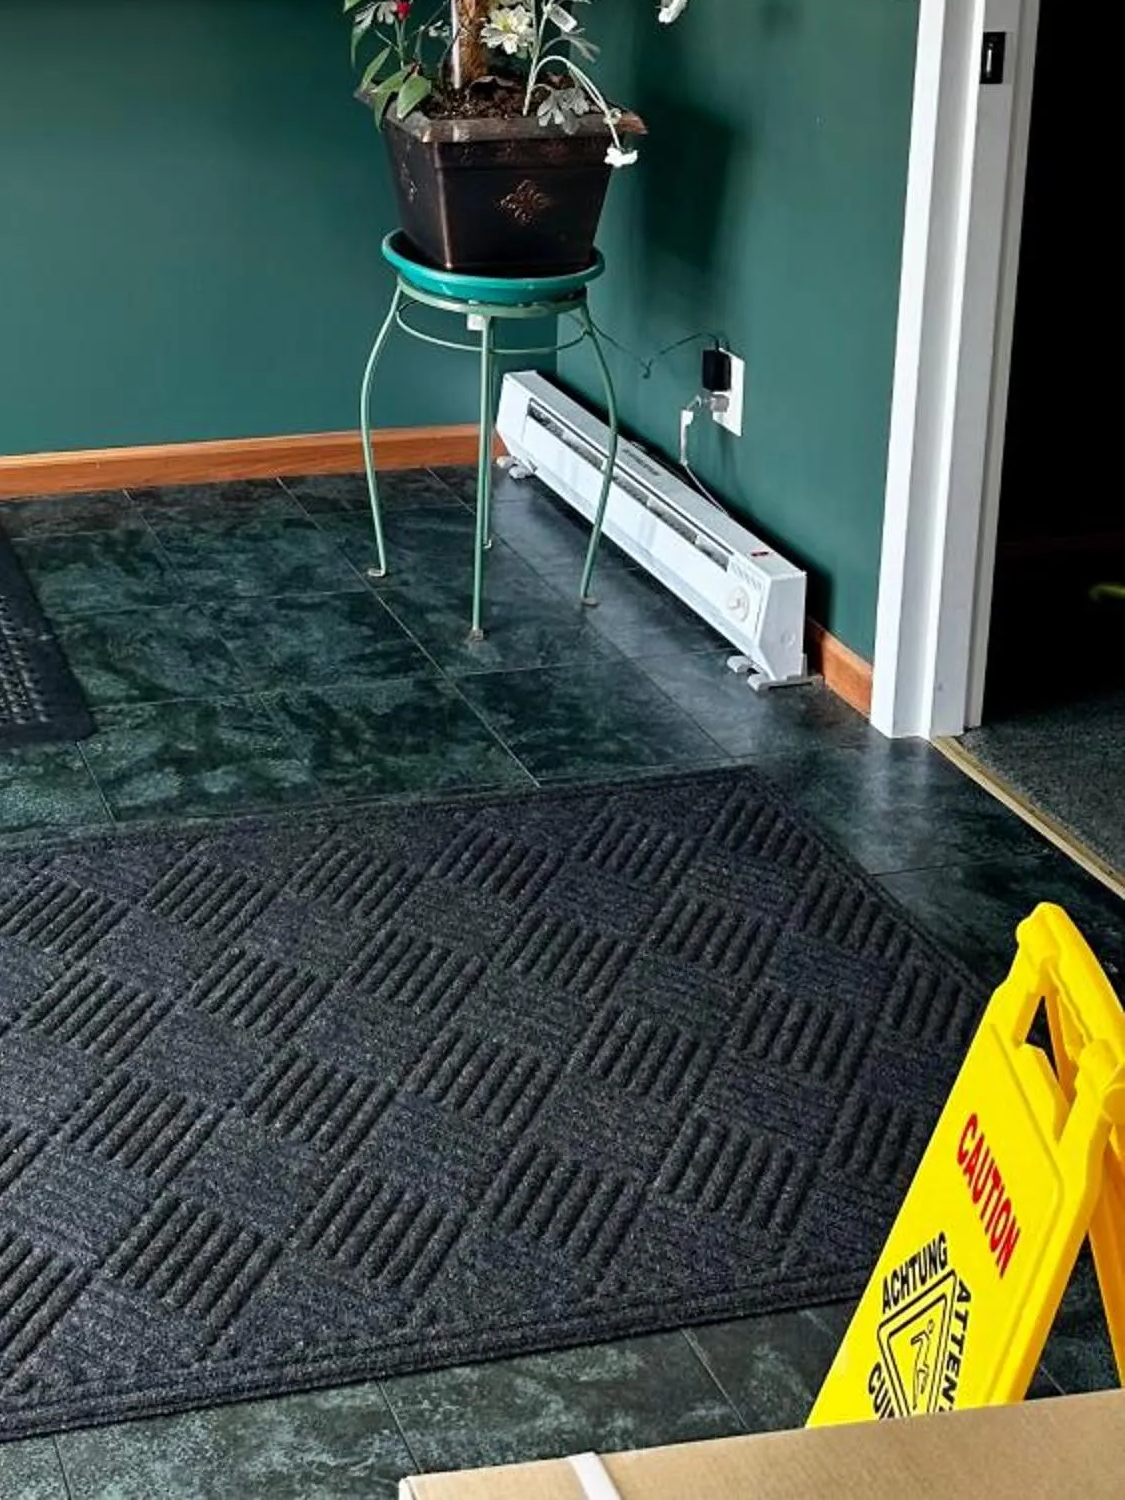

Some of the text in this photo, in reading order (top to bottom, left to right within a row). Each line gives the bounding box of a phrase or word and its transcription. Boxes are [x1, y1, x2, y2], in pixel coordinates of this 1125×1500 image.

[956, 1112, 1022, 1279] CAUTION
[882, 1230, 948, 1315] ACHTUNG
[939, 1278, 972, 1412] ATTEN
